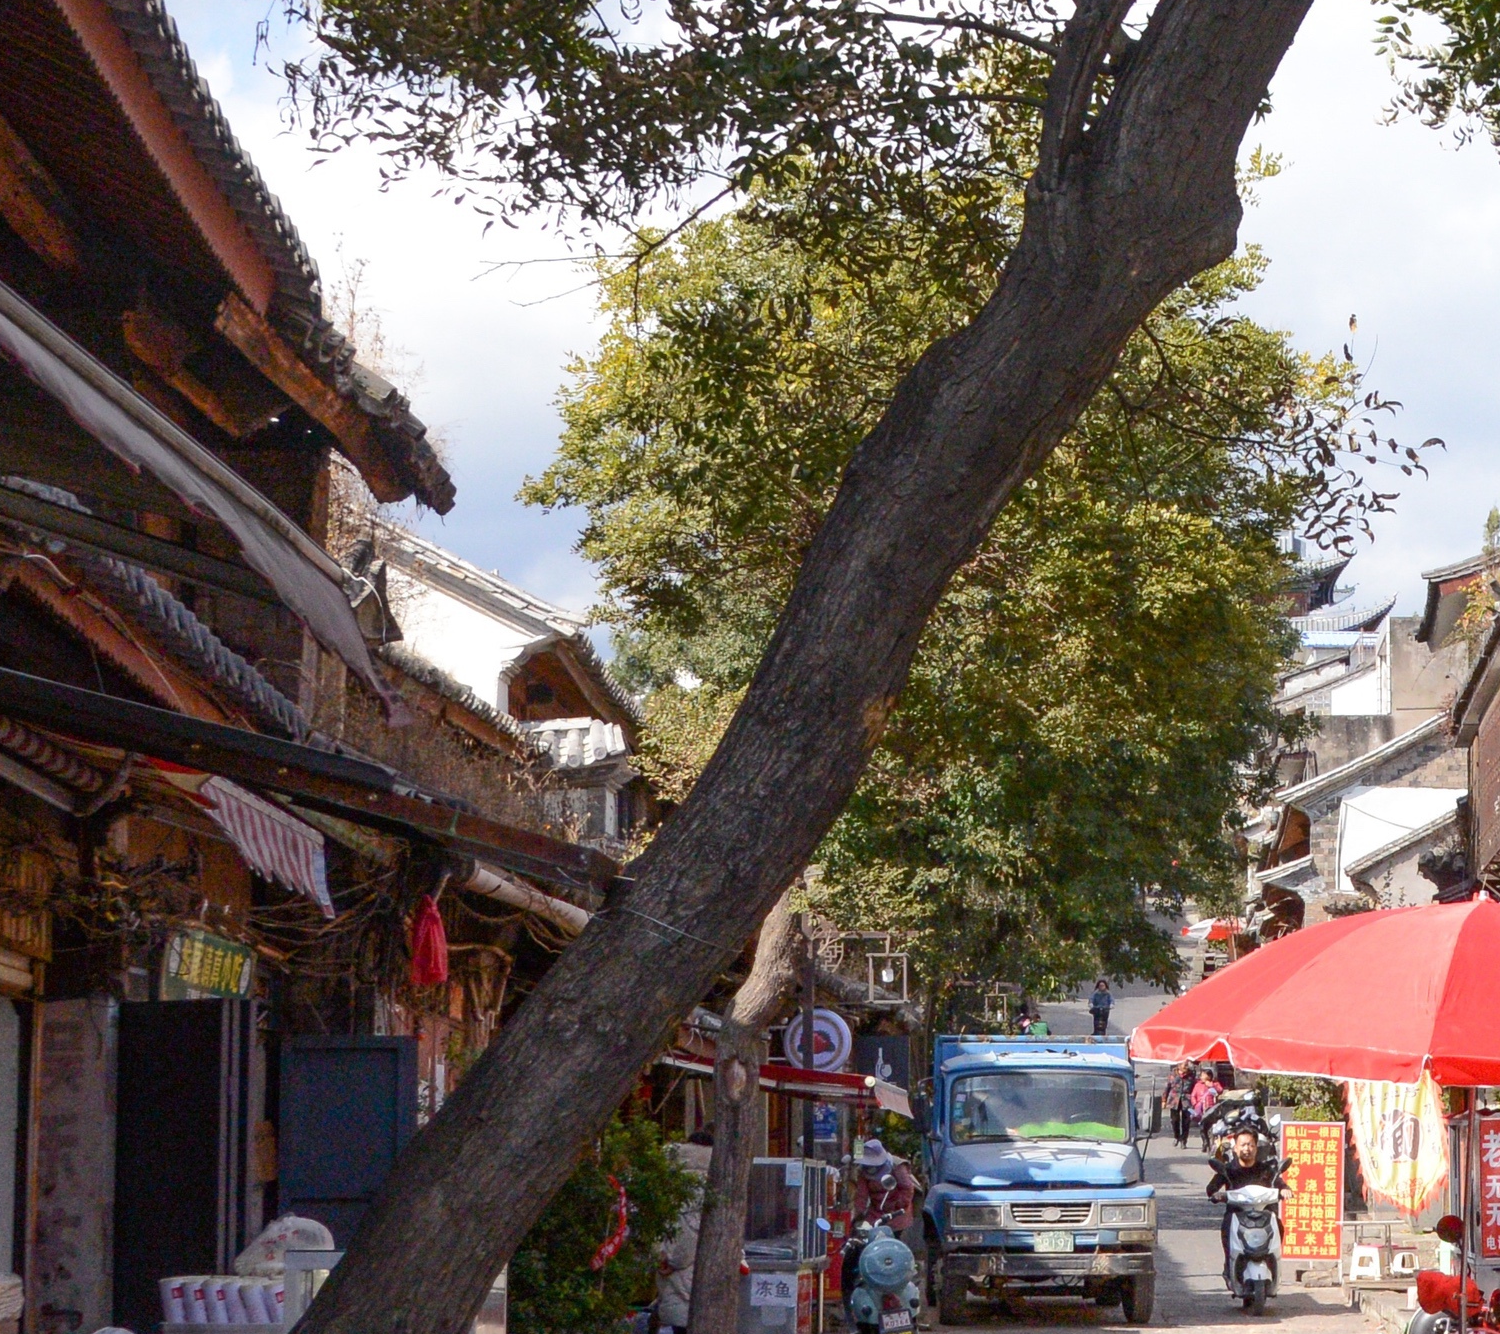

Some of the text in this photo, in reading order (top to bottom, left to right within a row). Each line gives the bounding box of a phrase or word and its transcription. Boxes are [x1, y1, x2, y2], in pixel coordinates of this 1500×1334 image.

[1286, 1126, 1340, 1138] 巍山一根面
[1286, 1139, 1338, 1152] 陕西凉皮
[1285, 1206, 1337, 1218] 河南烩面
[1285, 1219, 1337, 1232] 手工饺子
[756, 1280, 792, 1298] 冻鱼
